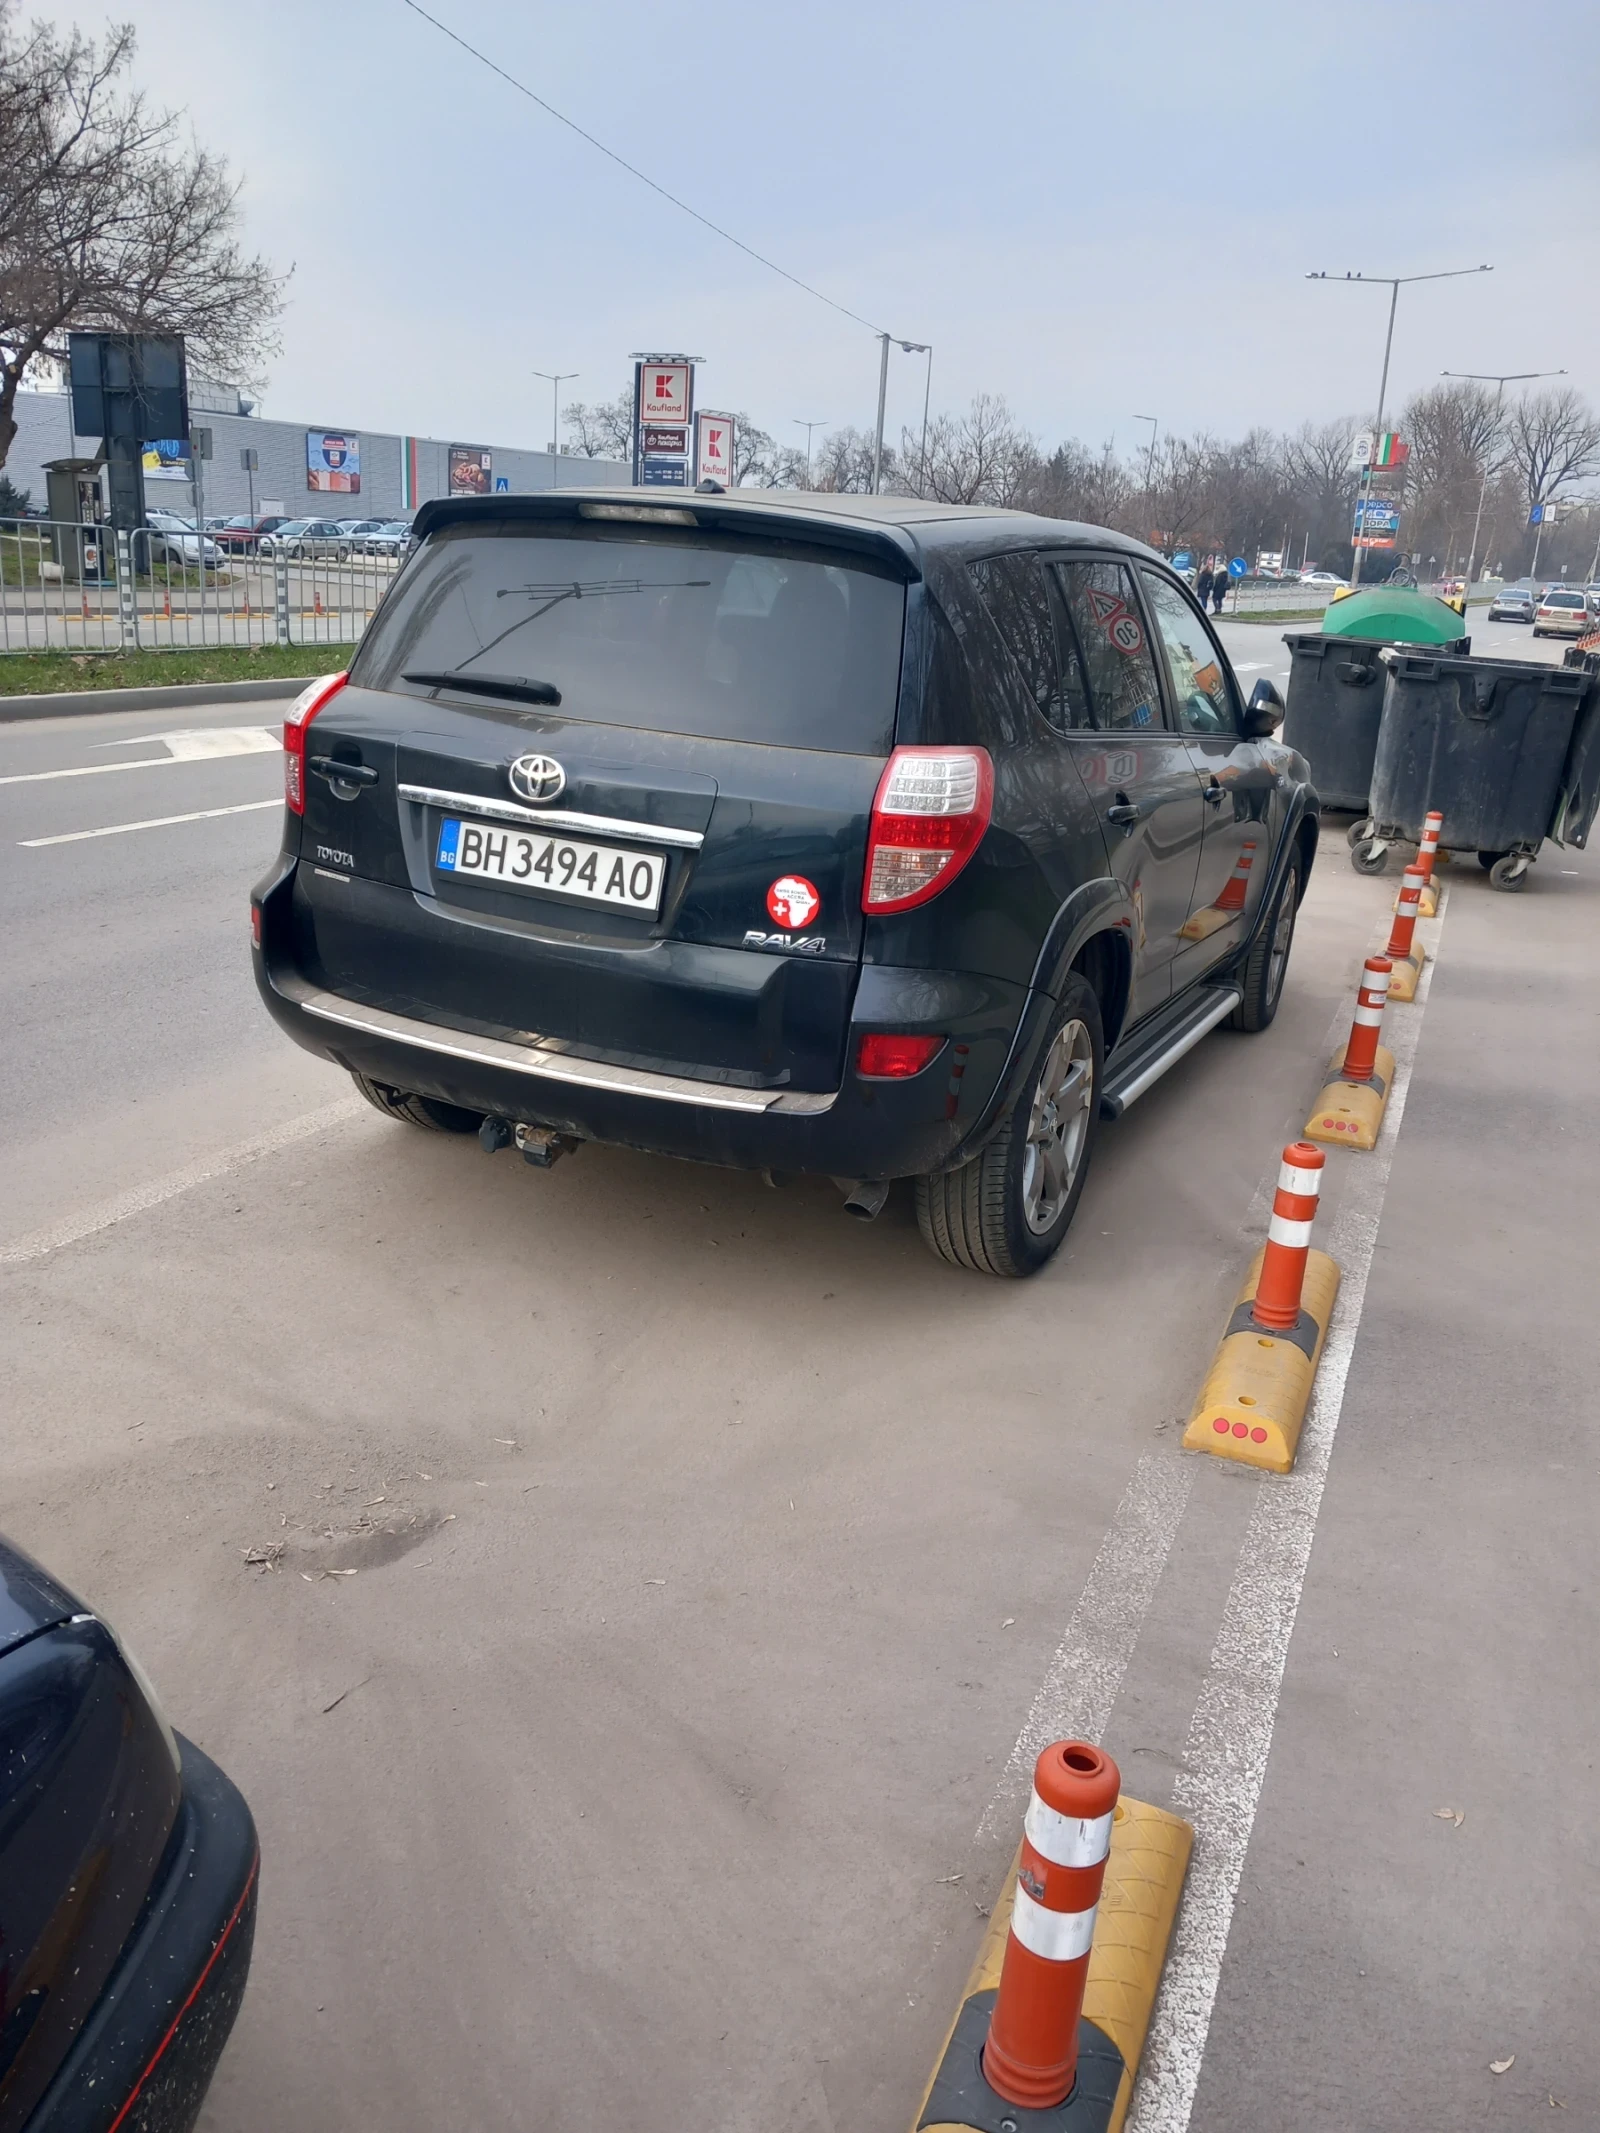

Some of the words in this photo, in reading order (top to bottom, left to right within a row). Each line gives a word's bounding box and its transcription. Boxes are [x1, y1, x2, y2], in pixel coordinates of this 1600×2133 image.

[647, 404, 682, 412] Kaufland
[702, 464, 726, 475] Kaufland
[316, 845, 355, 868] TOYOTA
[440, 851, 455, 864] BG
[742, 931, 826, 954] RAV4
